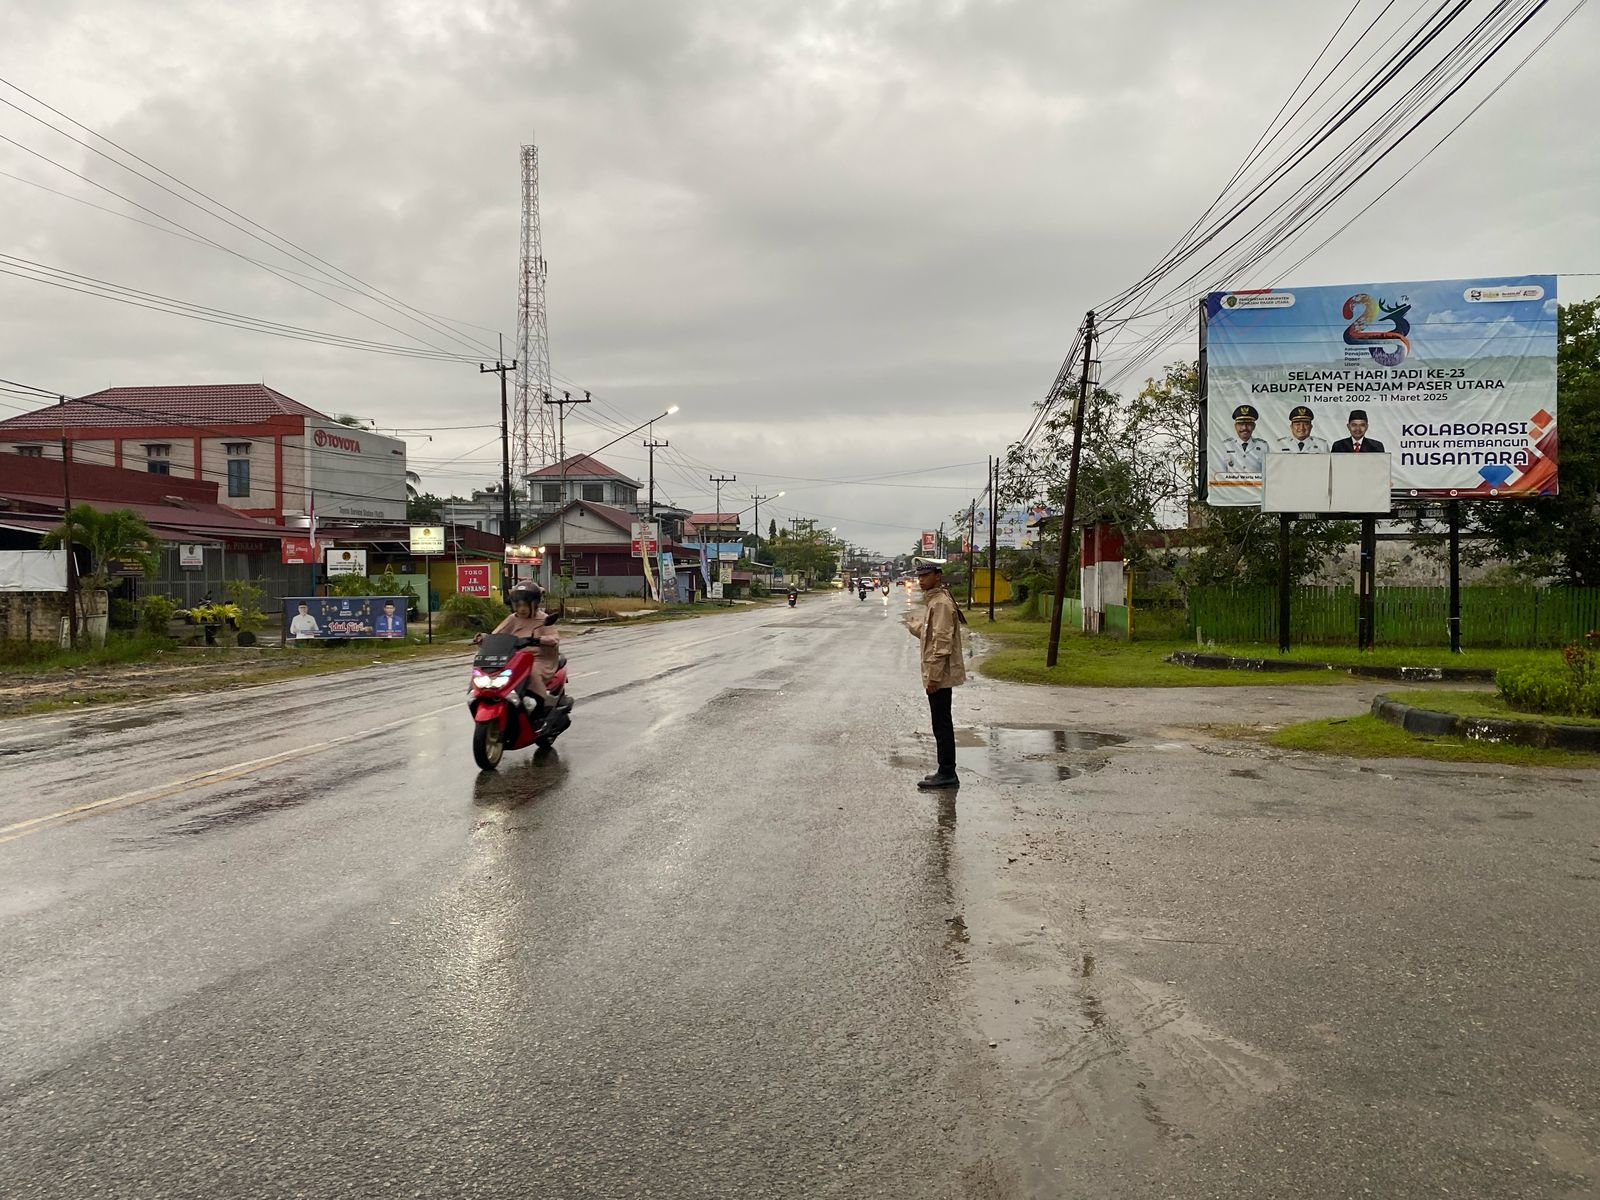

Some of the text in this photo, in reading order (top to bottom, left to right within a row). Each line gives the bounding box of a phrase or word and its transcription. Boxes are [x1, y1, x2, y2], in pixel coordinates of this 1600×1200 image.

[1288, 368, 1465, 381] SELAMAT HARI JADI KE-23
[1251, 379, 1505, 393] KABUPATEN PENAJAM PASER UTARA
[1313, 394, 1343, 402] Maret
[1345, 394, 1371, 402] 2002
[1380, 394, 1387, 402] 11
[1390, 393, 1421, 402] Maret
[1423, 393, 1448, 401] 2025
[1402, 422, 1528, 437] KOLABORASI
[327, 433, 361, 454] TOYOTA
[461, 585, 487, 593] PINRANG
